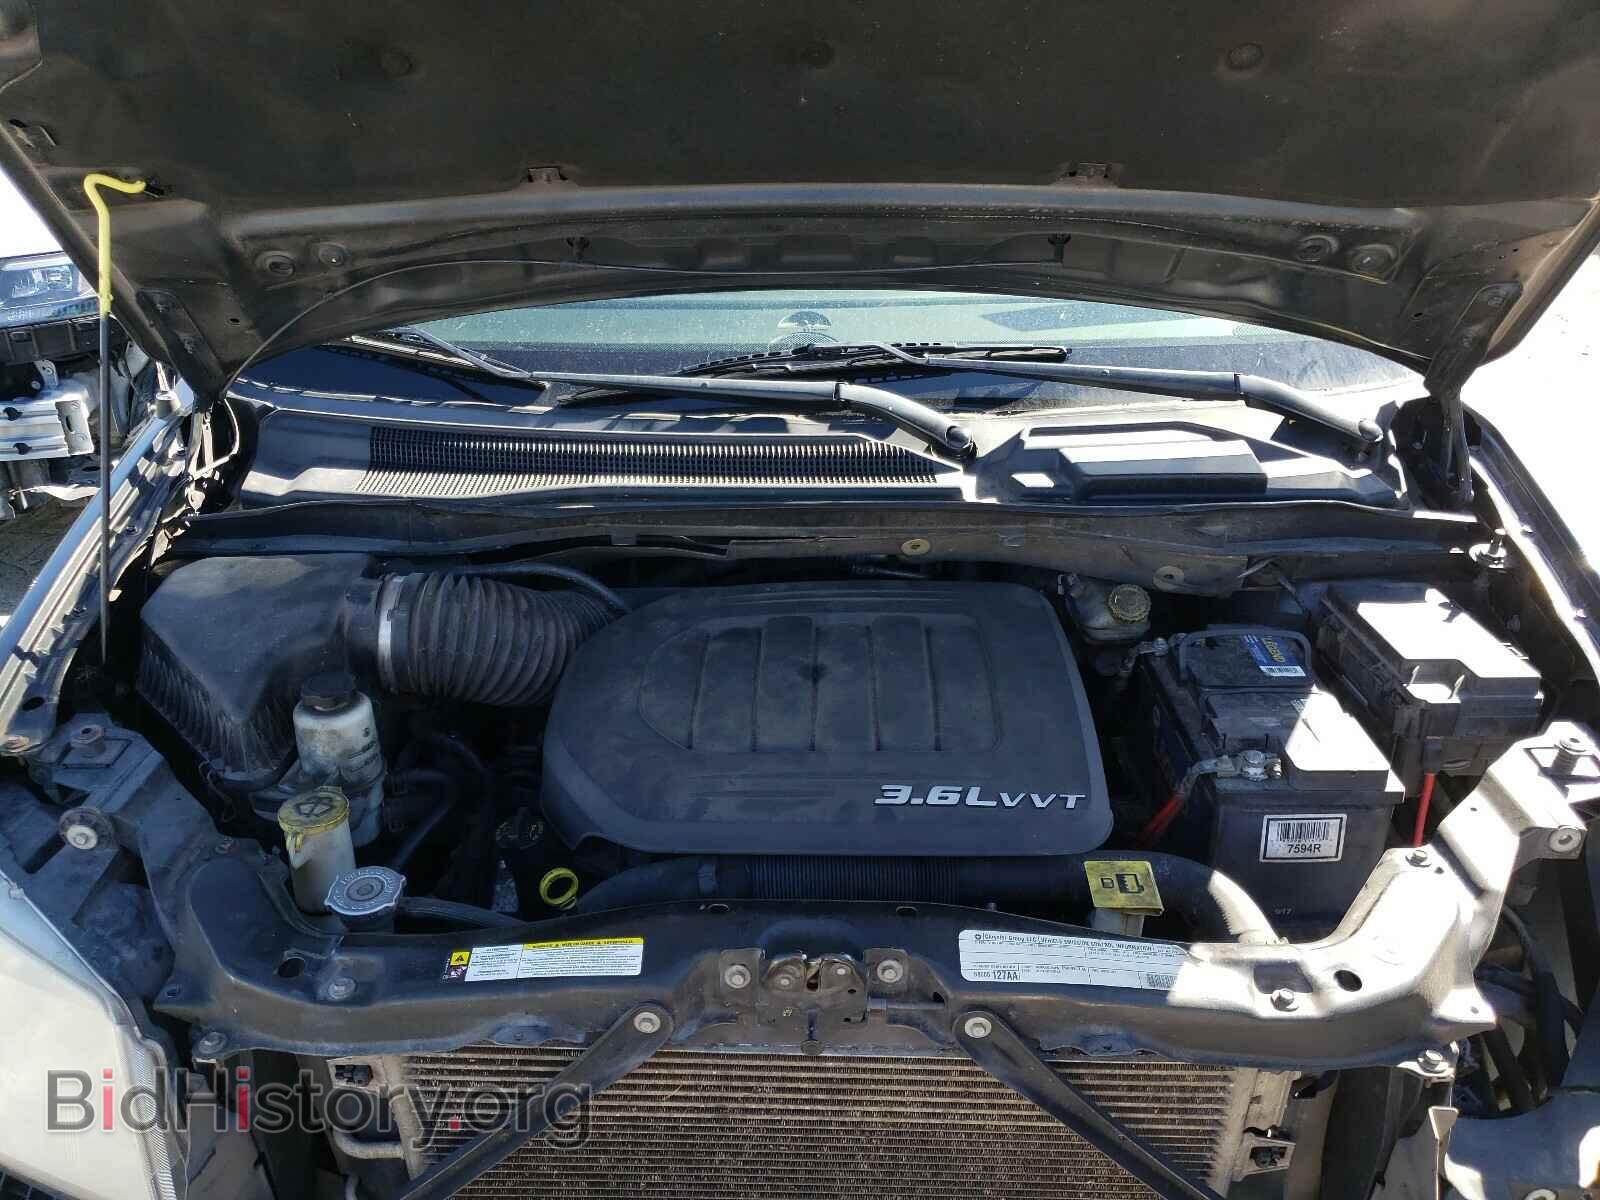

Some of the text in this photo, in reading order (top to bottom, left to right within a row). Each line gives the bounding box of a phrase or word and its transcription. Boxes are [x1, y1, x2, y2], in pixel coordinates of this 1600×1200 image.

[874, 784, 1086, 809] 3.6L VVT
[1287, 843, 1321, 854] 7594R
[993, 970, 1018, 981] 127AA
